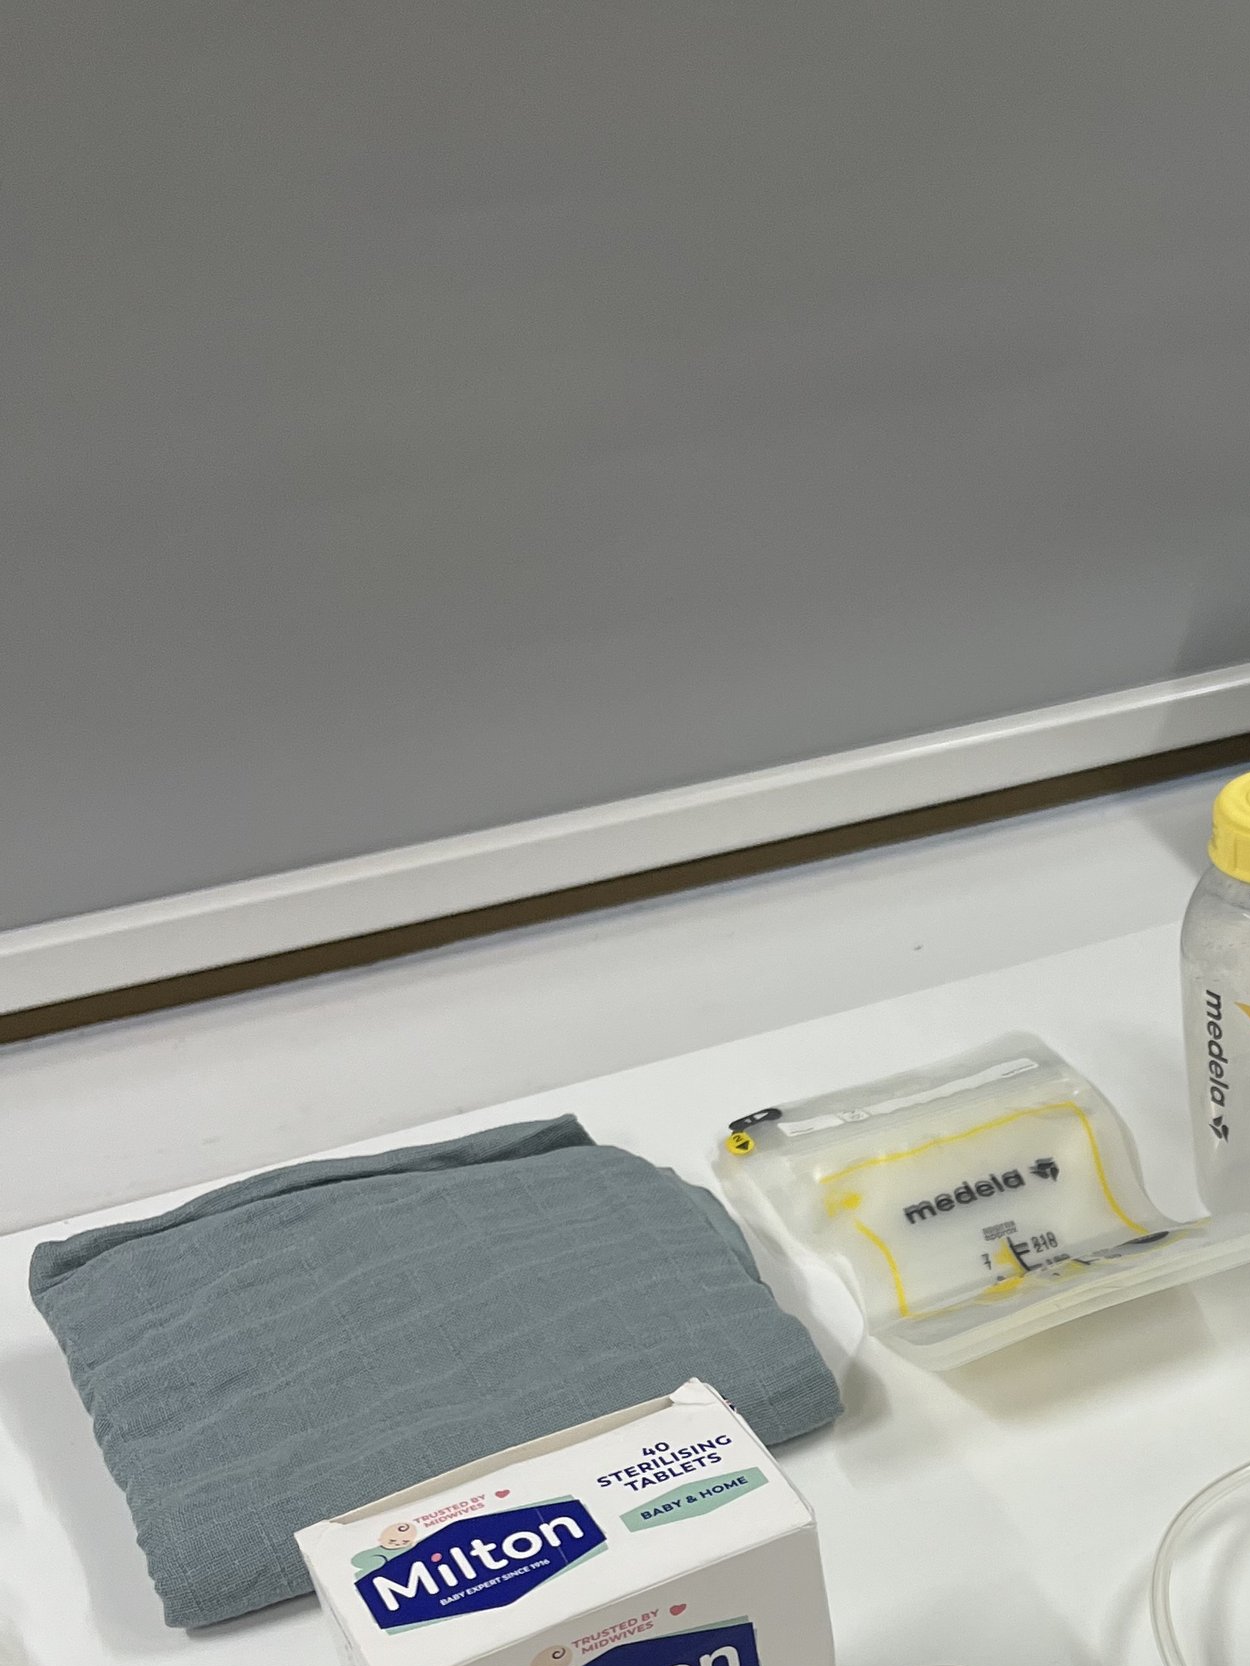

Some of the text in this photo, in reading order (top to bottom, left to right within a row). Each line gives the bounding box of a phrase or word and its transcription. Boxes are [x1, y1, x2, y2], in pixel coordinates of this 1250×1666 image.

[1205, 989, 1230, 1107] medela
[903, 1168, 1026, 1224] medela
[597, 1434, 732, 1487] STERILISING
[642, 1441, 670, 1457] 40
[624, 1452, 722, 1491] TABLETS
[413, 1494, 486, 1524] TRUSTED BY
[424, 1502, 486, 1528] MIDWIVES
[640, 1475, 749, 1520] BABY & HOME
[372, 1515, 584, 1611] Milton
[439, 1558, 551, 1606] BABY EXPERT SINCE 1916
[571, 1609, 660, 1649] TRUSTED BY
[581, 1620, 655, 1655] MIDWIVES
